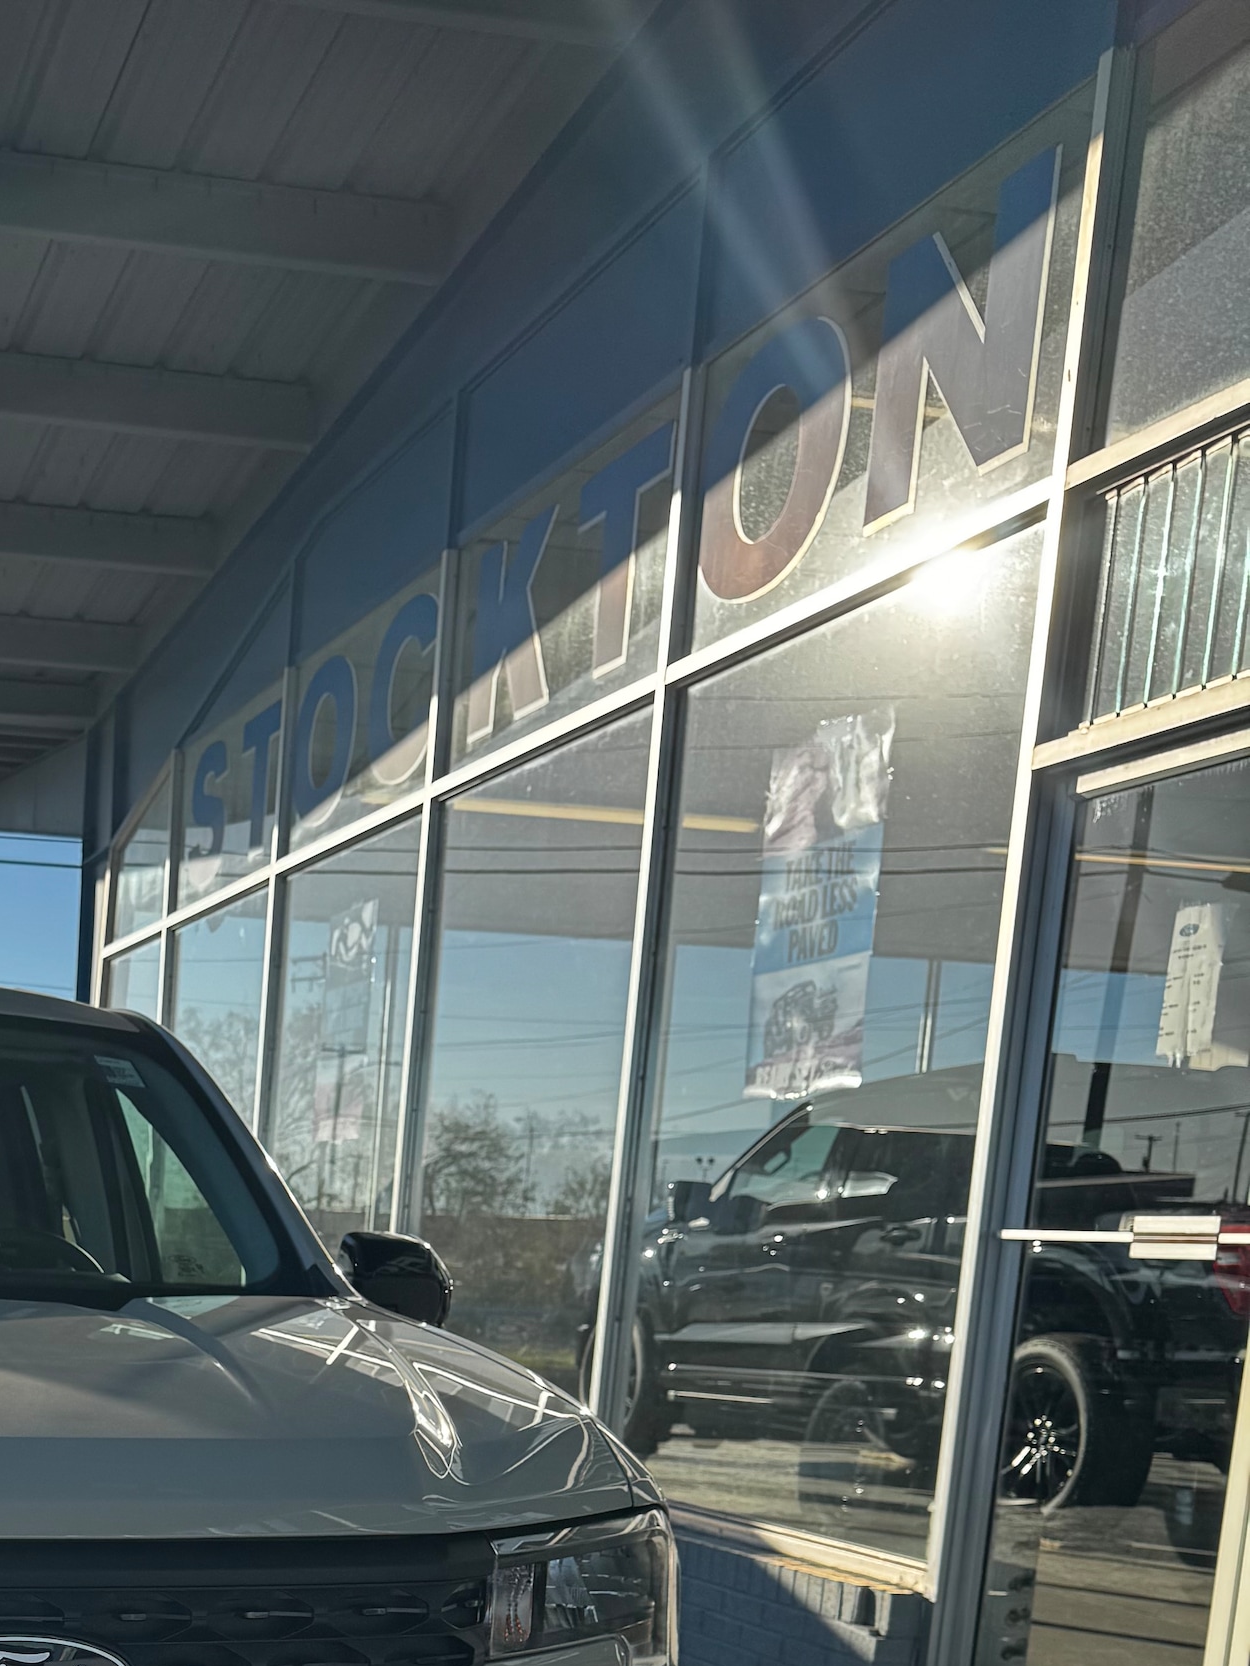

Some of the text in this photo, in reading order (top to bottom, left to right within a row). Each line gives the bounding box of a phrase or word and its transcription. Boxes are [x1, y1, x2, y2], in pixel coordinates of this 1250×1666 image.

[188, 143, 1063, 892] STOCKTON
[785, 839, 857, 892] TAKE THE
[773, 875, 859, 932] ROAD LESS
[787, 919, 839, 963] PAVED
